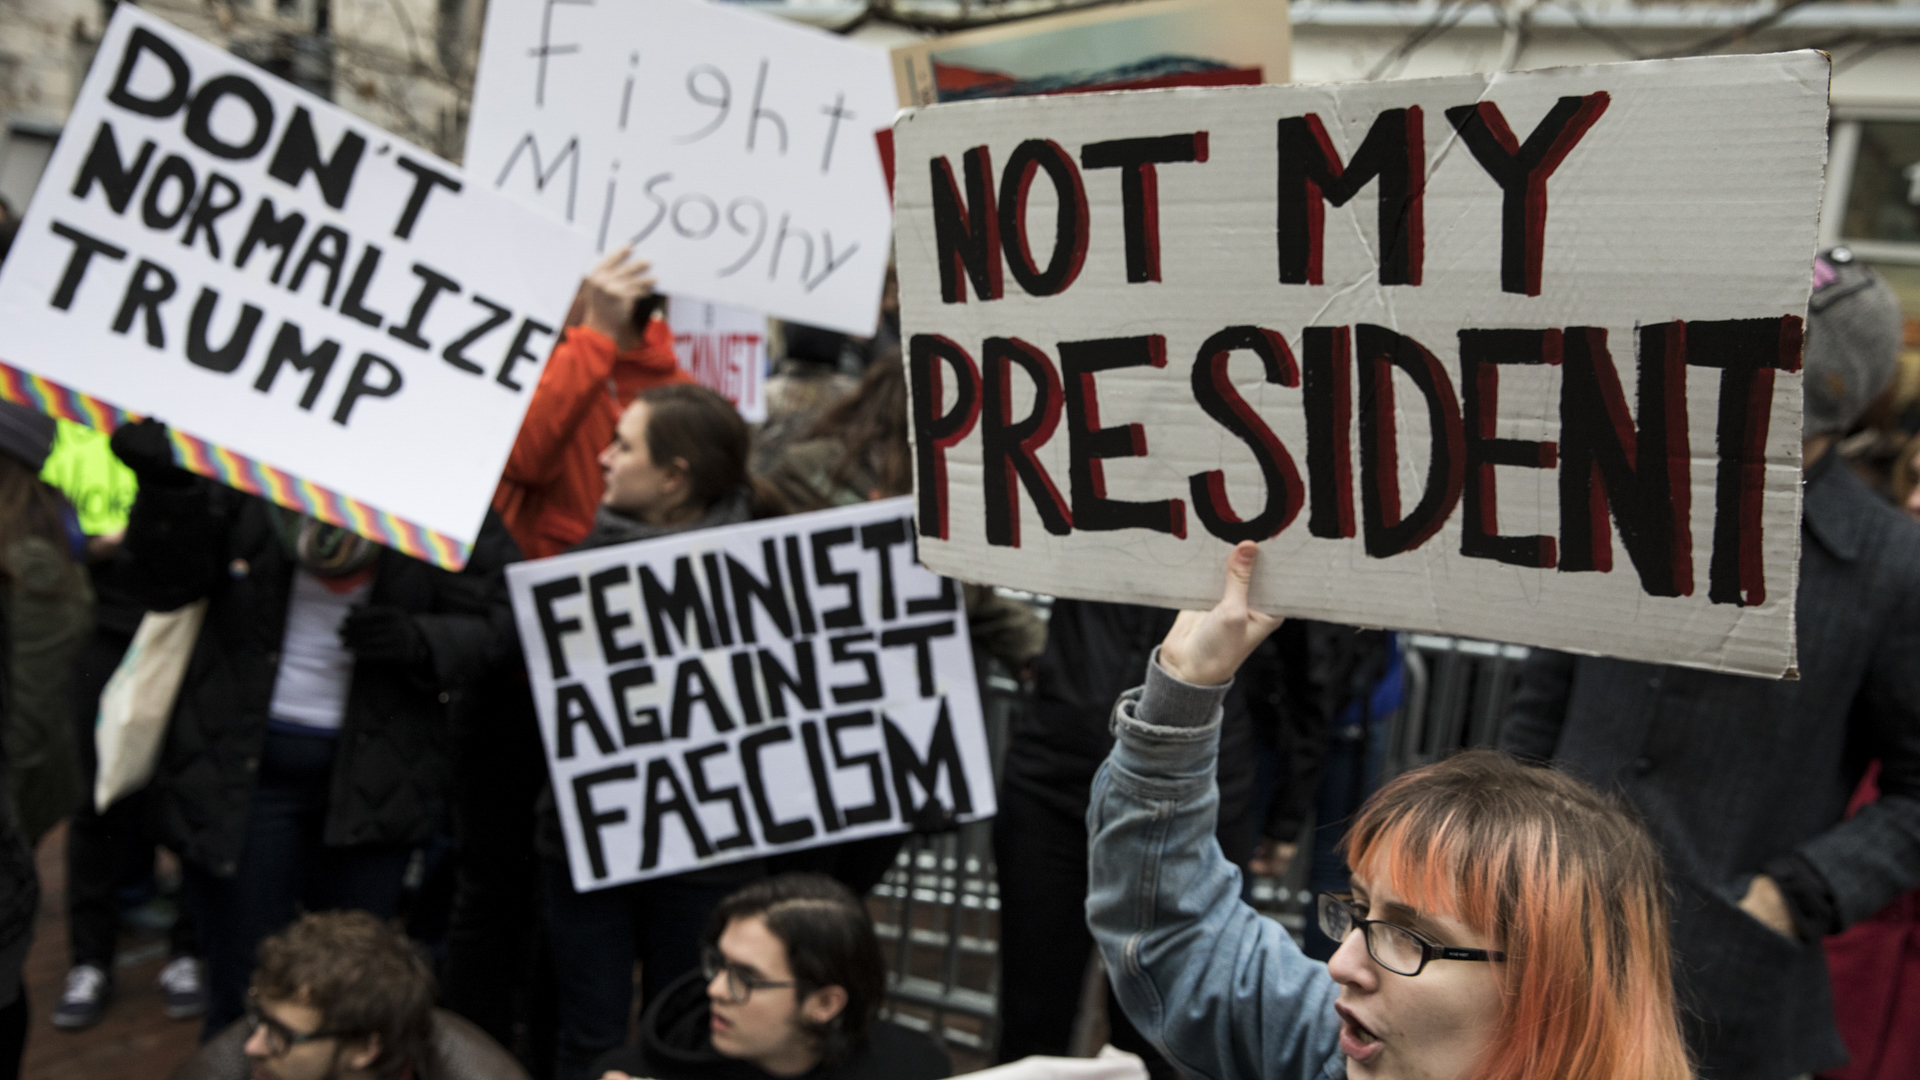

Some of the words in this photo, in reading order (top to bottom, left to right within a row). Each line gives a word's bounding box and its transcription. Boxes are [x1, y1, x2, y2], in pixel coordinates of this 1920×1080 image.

[106, 26, 463, 242] DON'T
[528, 0, 858, 173] Fight
[70, 120, 554, 393] NORMALIZE
[494, 130, 860, 293] Misogny
[930, 130, 1209, 305] NOT
[1278, 91, 1610, 297] MY
[50, 221, 403, 426] TRUMP
[909, 314, 1804, 608] PRESIDENT
[556, 619, 956, 760] AGAINST
[571, 696, 975, 880] FASCISM
